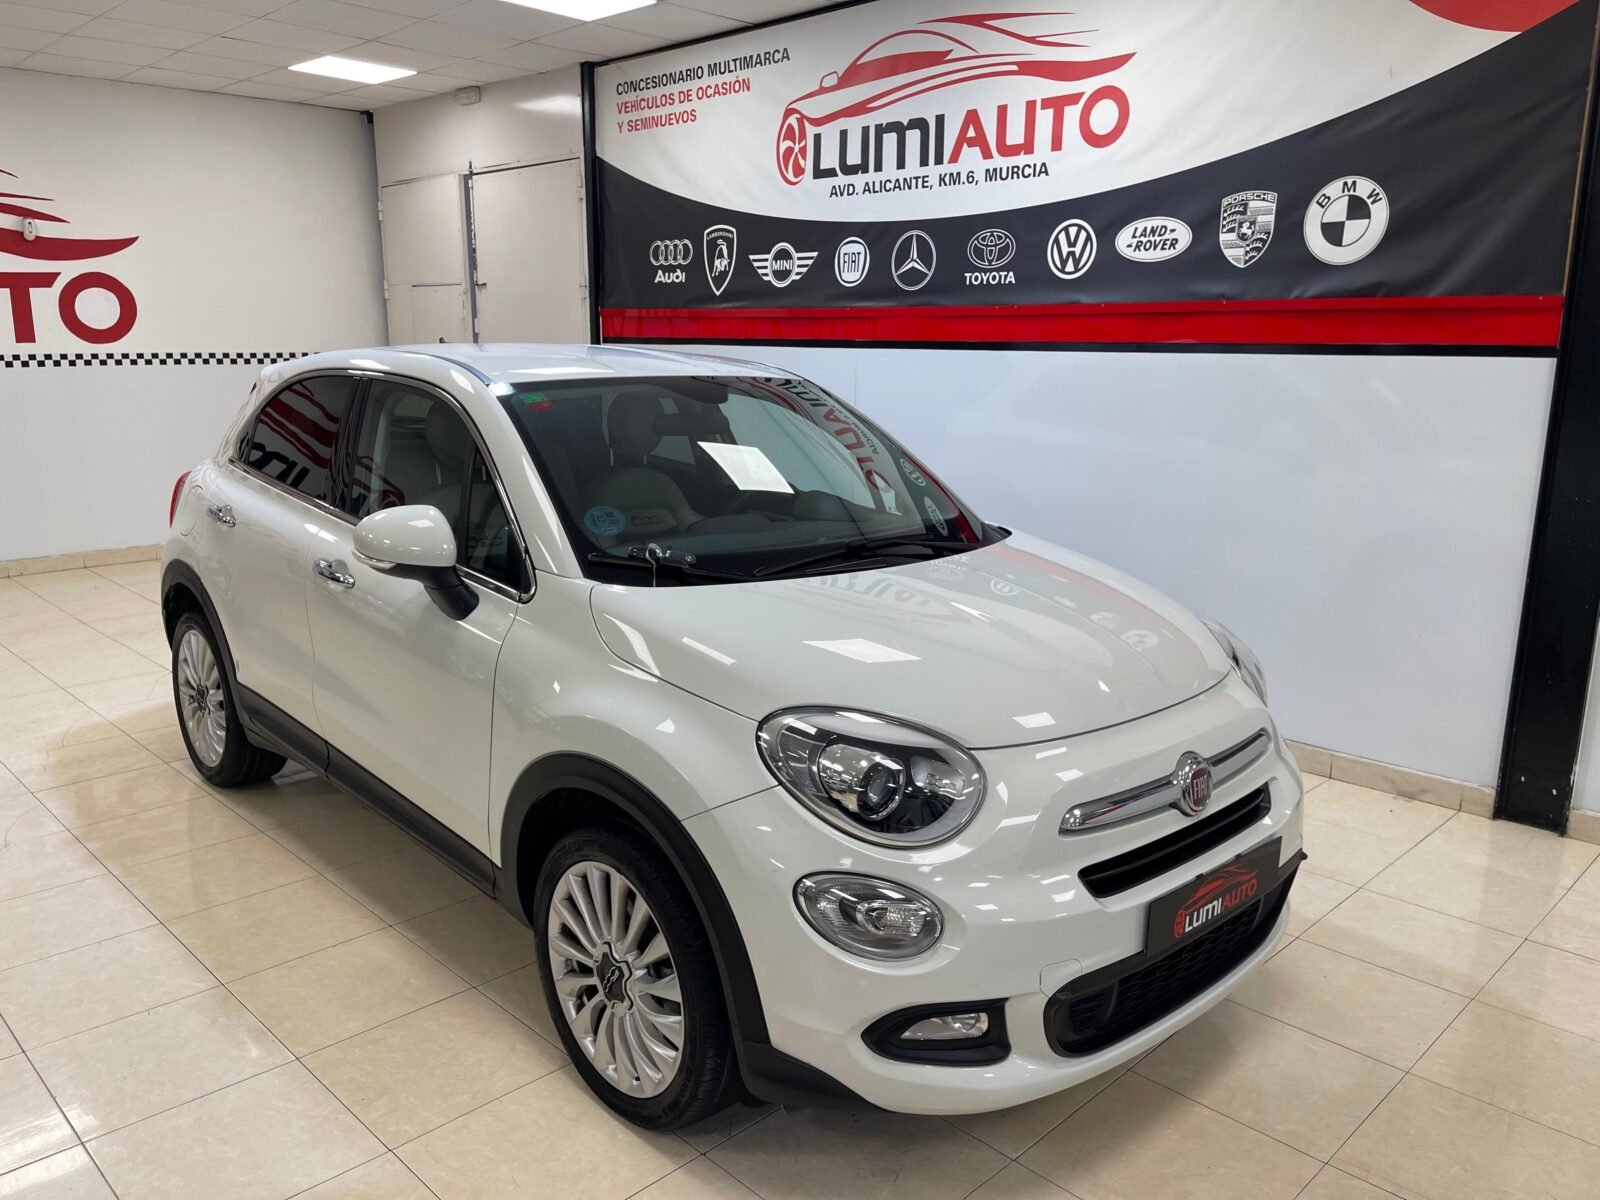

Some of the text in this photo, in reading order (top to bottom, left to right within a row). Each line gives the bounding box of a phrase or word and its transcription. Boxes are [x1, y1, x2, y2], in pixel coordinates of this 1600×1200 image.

[616, 47, 791, 96] CONCESIONARIO MULTIMARCA
[616, 75, 751, 115] VEHÍCULOS DE OCASIÓN
[617, 108, 697, 133] Y SEMINUEVOS
[829, 161, 1050, 198] AVD. ALICANTE, KM.6, MURCIA
[1223, 192, 1276, 206] PORSCHE
[772, 259, 793, 271] MINI
[842, 251, 862, 274] FIAT
[653, 268, 686, 284] Audi
[964, 271, 1016, 286] TOYOTA
[1192, 773, 1209, 800] FIAT
